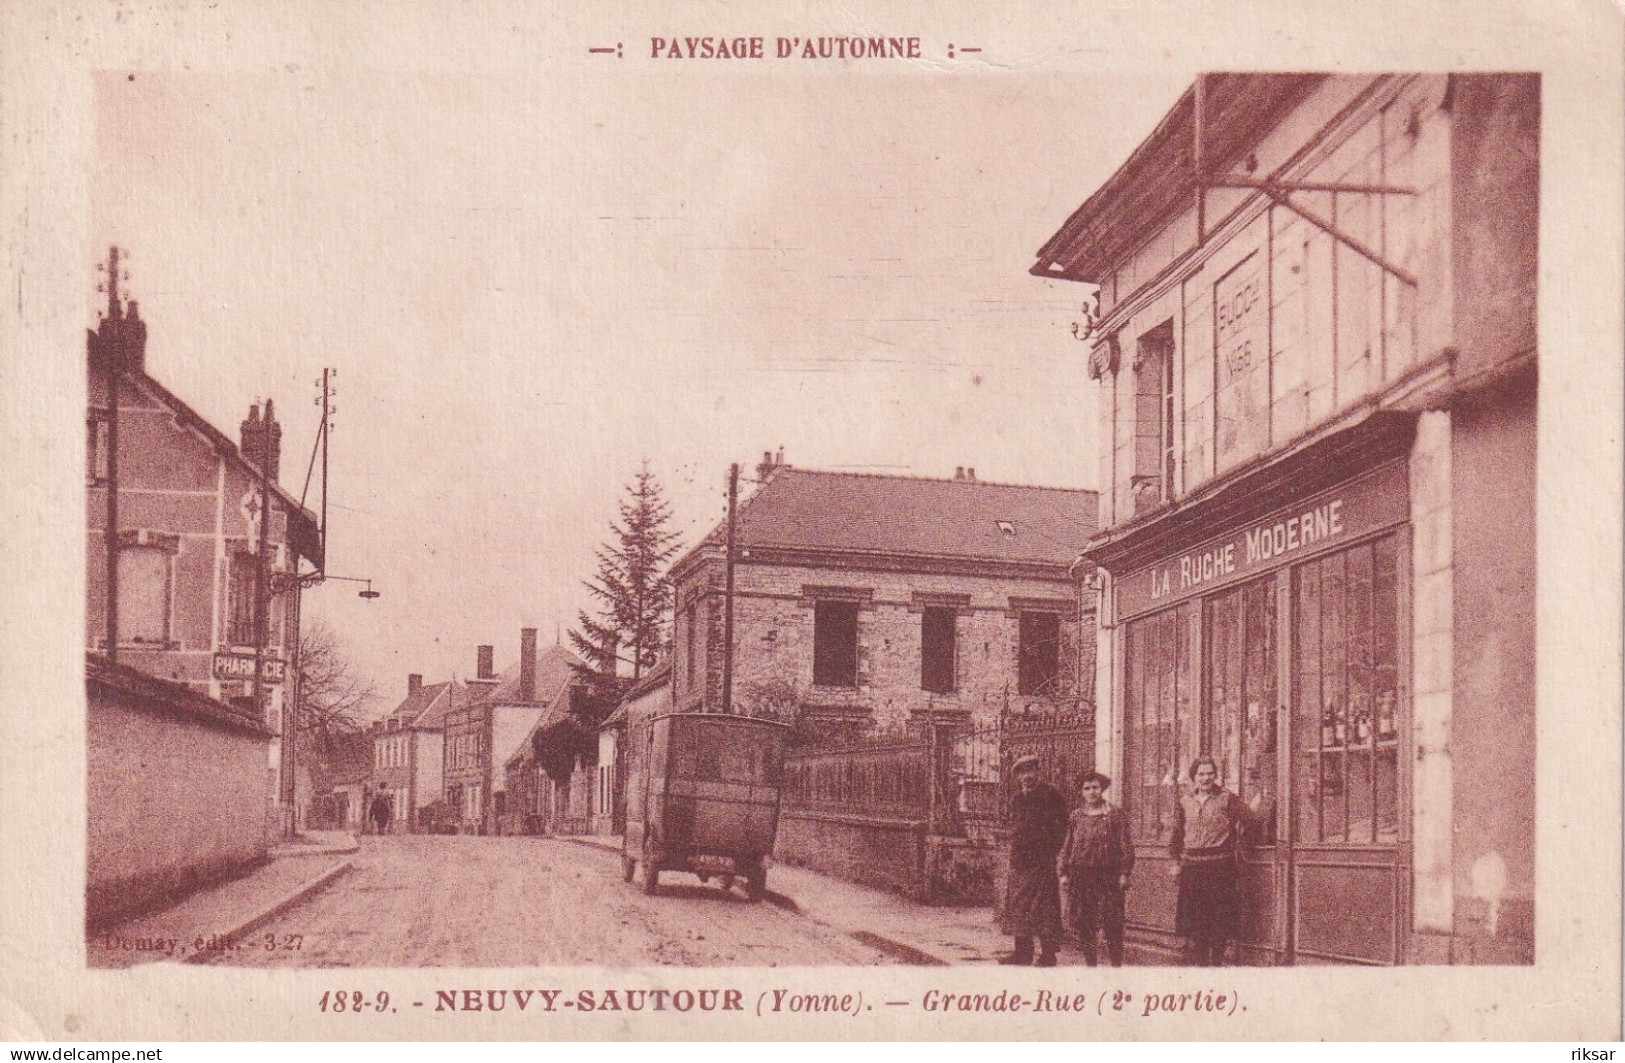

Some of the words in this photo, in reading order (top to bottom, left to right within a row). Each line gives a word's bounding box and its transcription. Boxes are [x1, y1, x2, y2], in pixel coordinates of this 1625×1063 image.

[1151, 568, 1171, 600] LA
[1180, 543, 1236, 590] RUCHE
[1245, 499, 1344, 565] MODERNE
